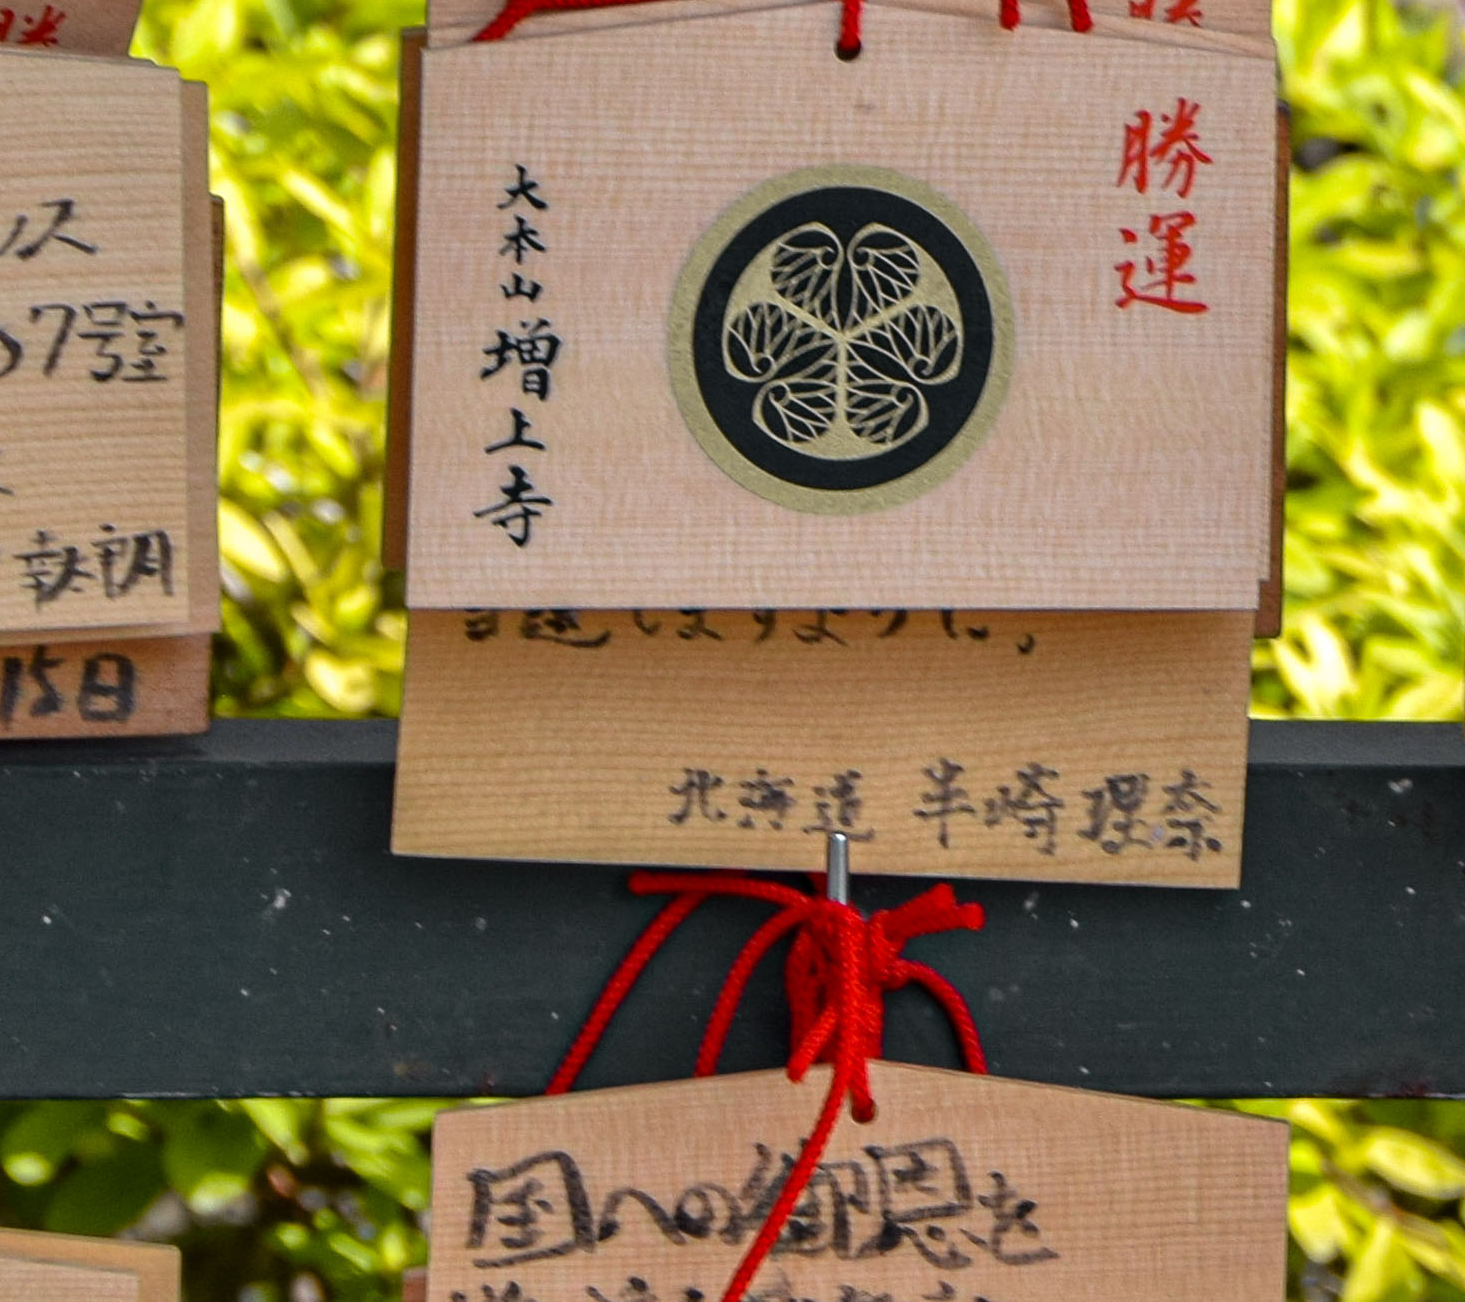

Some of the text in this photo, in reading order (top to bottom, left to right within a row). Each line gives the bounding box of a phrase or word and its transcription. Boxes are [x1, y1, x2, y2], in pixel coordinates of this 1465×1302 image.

[473, 162, 562, 549] 大本山増上寺
[1114, 97, 1214, 315] 勝運
